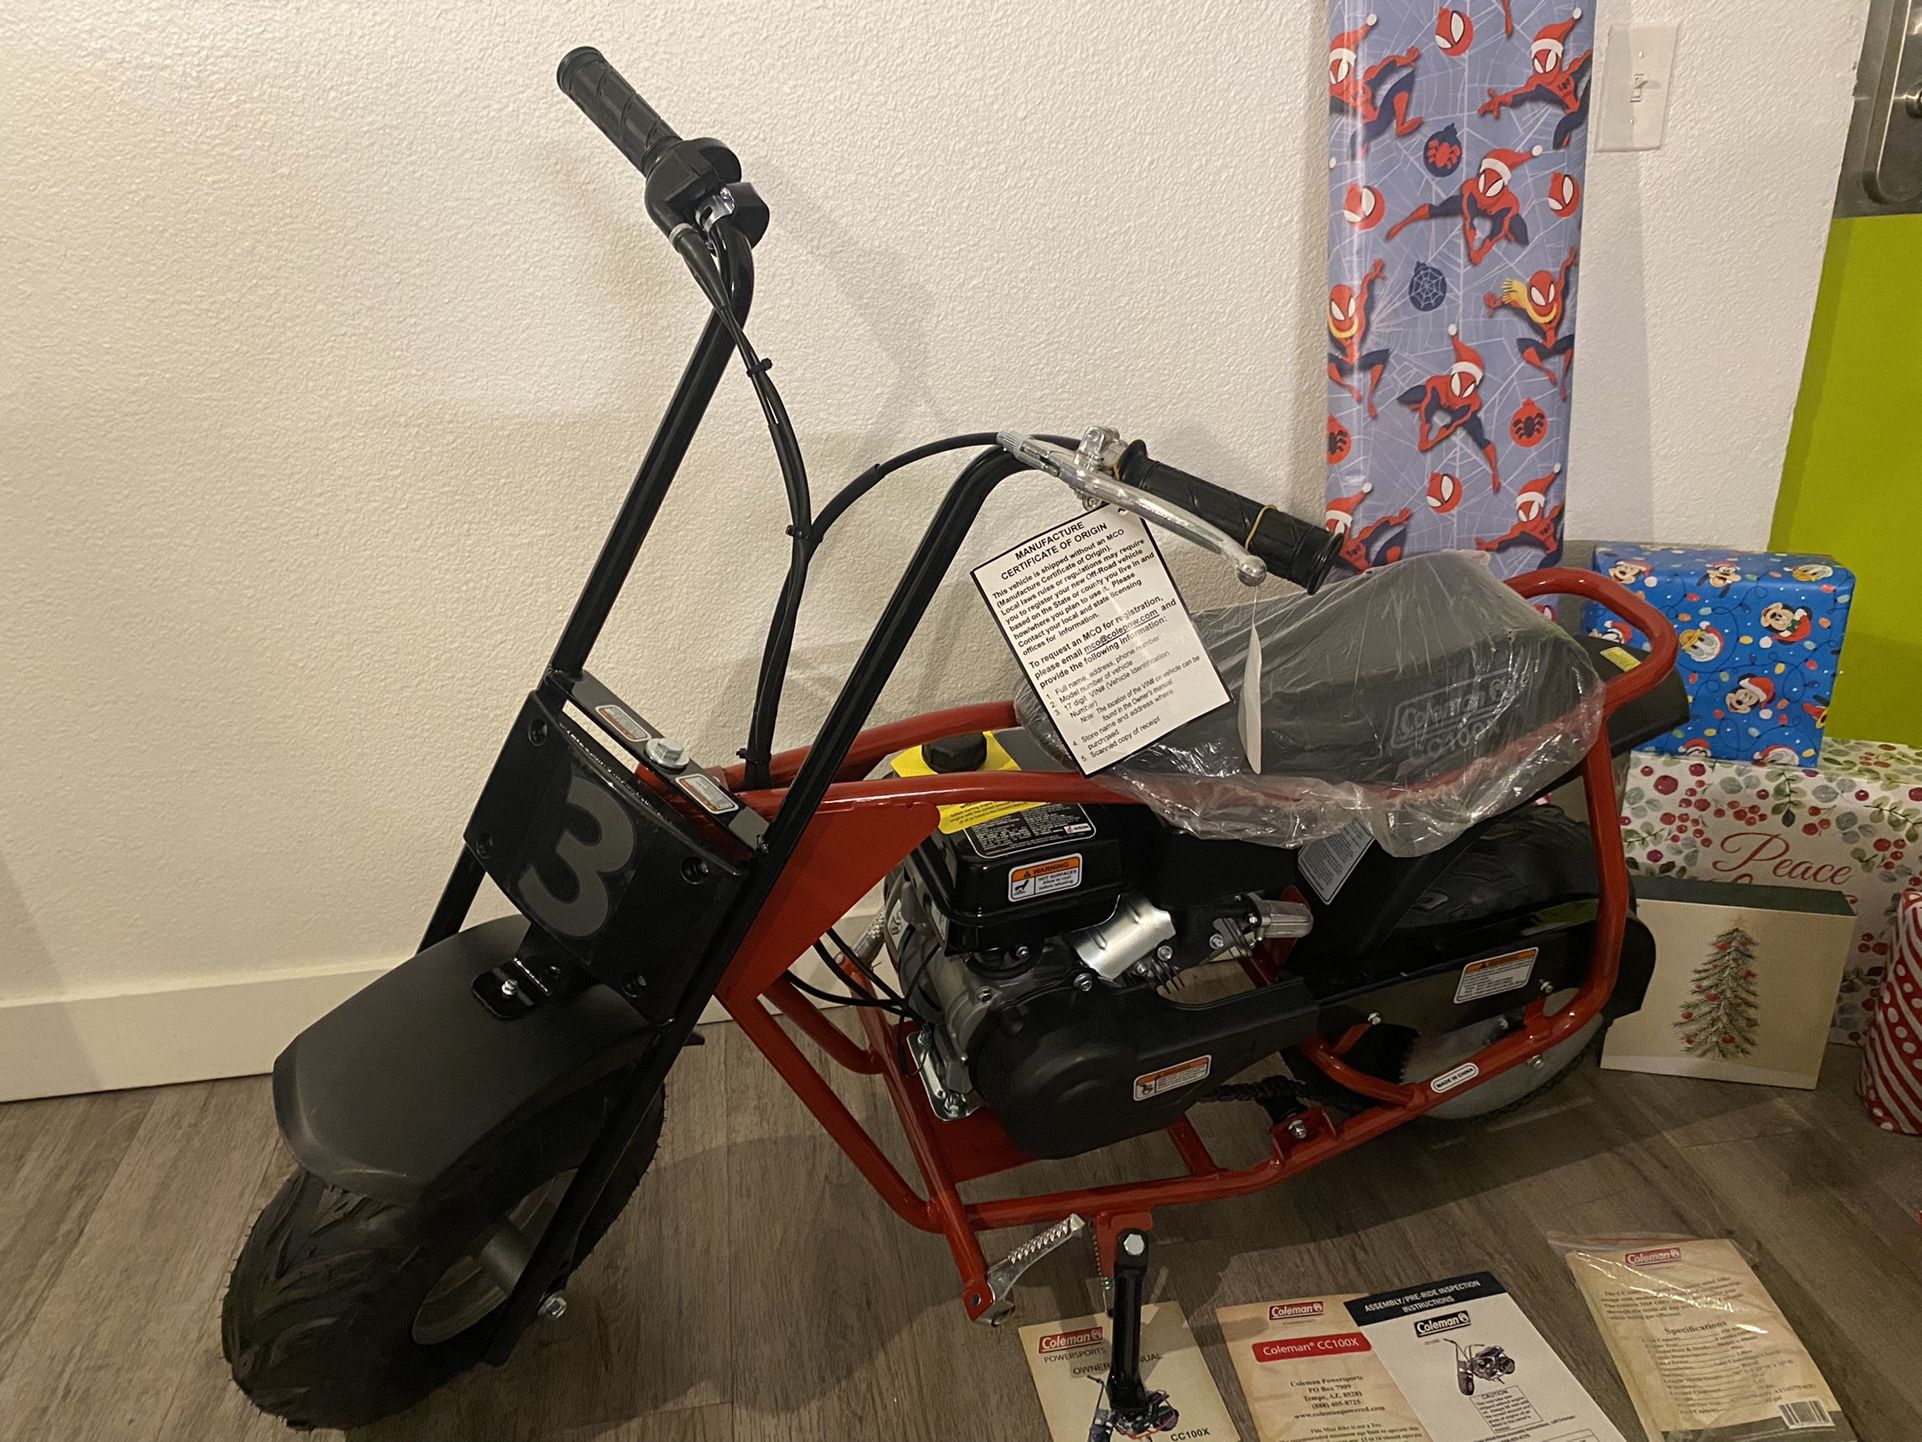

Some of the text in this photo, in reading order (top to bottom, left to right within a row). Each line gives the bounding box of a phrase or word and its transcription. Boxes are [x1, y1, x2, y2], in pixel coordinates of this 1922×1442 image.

[1001, 522, 1107, 580] CERTIFICATE OF ORIGIN
[1014, 521, 1084, 560] MANUFACTURE
[992, 588, 1008, 599] This
[1008, 575, 1032, 590] vehicle
[1040, 555, 1068, 573] shipped
[1068, 542, 1095, 558] without
[1106, 528, 1124, 540] MCO
[996, 544, 1111, 608] (Manufacture Certificate of Origin).
[1000, 601, 1020, 615] Local
[1019, 593, 1036, 605] laws
[1036, 583, 1054, 596] rules
[1063, 558, 1102, 582] regulations
[1102, 551, 1118, 562] may
[1118, 538, 1144, 554] require
[1004, 613, 1019, 624] you
[1027, 594, 1053, 612] register
[1053, 585, 1069, 598] your
[1070, 577, 1085, 588] new
[1085, 560, 1117, 580] Off-Road
[1117, 549, 1142, 564] vehicle
[1008, 616, 1030, 631] based
[1030, 612, 1041, 620] on
[1040, 605, 1052, 614] the
[1052, 595, 1071, 608] State
[1080, 578, 1103, 593] county
[1103, 570, 1118, 581] you
[1117, 564, 1131, 573] live
[1140, 551, 1154, 562] and
[1013, 617, 1050, 640] how/where
[1050, 609, 1064, 621] you
[1064, 601, 1080, 613] plan
[1088, 589, 1101, 599] use
[1111, 572, 1135, 587] Please
[1017, 579, 1142, 647] Contact your local and state licensing
[1022, 612, 1099, 655] offices for information.
[1028, 596, 1163, 668] To request an MCO for registration,
[1034, 598, 1176, 680] please email mco@colepow.com and
[1039, 615, 1166, 689] provide the following information:
[1054, 684, 1068, 695] Full
[1088, 660, 1115, 677] address,
[1115, 648, 1135, 663] phone
[1058, 688, 1079, 703] Model
[1079, 676, 1103, 692] number
[1103, 671, 1111, 679] of
[1110, 660, 1133, 675] vehicle
[1063, 702, 1071, 710] 17
[1073, 695, 1087, 706] digit
[1088, 684, 1105, 697] VIN#
[1105, 671, 1130, 689] (Vehicle
[1129, 650, 1169, 674] Identification
[1095, 705, 1107, 714] The
[1106, 694, 1126, 708] location
[1126, 689, 1132, 697] of
[1132, 686, 1141, 694] the
[1140, 678, 1154, 688] VIN#
[1162, 664, 1181, 677] vehicle
[1181, 659, 1192, 667] can
[1069, 700, 1098, 718] Number)
[1080, 730, 1099, 742] Store
[1098, 720, 1116, 733] name
[1116, 712, 1129, 723] and
[1129, 699, 1153, 716] address
[1153, 689, 1173, 702] where
[1101, 709, 1117, 721] found
[1122, 701, 1132, 709] the
[1087, 729, 1119, 750] purchased
[1089, 740, 1117, 757] Scanned
[1117, 732, 1132, 744] copy
[1132, 727, 1139, 735] of
[1139, 715, 1160, 731] receipt
[518, 777, 634, 937] 3
[1033, 862, 1069, 874] WARNING
[1712, 832, 1852, 885] Peace
[1627, 1251, 1670, 1264] Coleman
[1271, 1305, 1313, 1317] Coleman
[1364, 1280, 1481, 1312] ASSEMBLY/PRE-RIDE INSPECTION
[1402, 1295, 1455, 1313] INSTRUCTIONS
[1042, 1332, 1090, 1349] Coleman
[1317, 1337, 1360, 1350] CC100X
[1416, 1316, 1459, 1334] Coleman
[1664, 1320, 1727, 1336] Specifications
[1044, 1347, 1106, 1363] POWERSPORTS
[1170, 1427, 1211, 1442] CC100X
